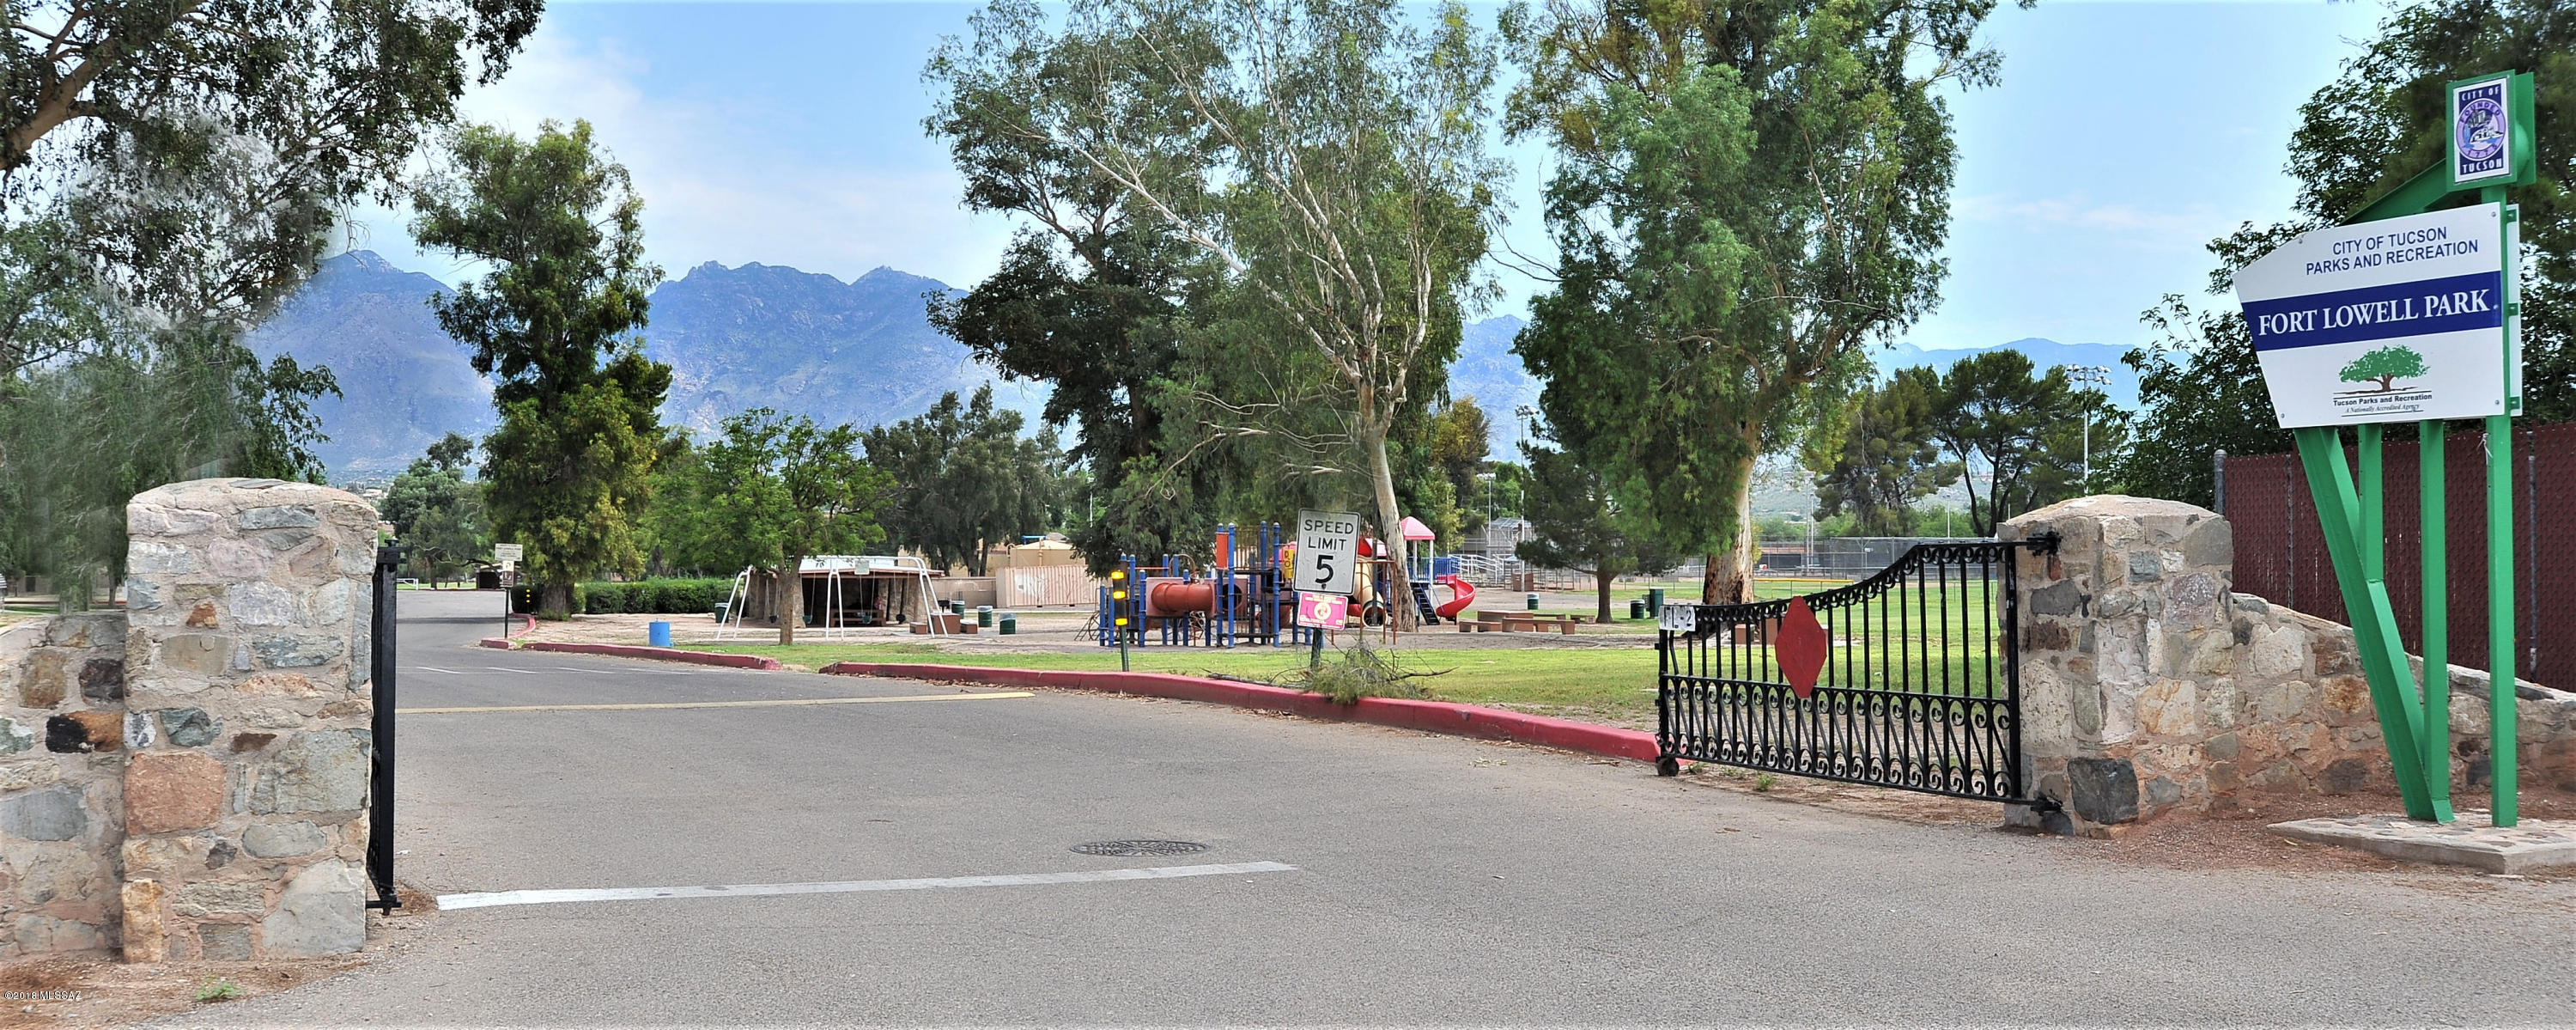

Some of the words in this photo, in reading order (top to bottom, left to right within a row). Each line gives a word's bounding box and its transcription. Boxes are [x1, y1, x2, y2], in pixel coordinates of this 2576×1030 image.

[2462, 89, 2484, 101] CITY
[2488, 86, 2500, 95] OF
[2460, 102, 2500, 123] FOUNDED
[2463, 158, 2502, 174] TUCSON
[2333, 239, 2362, 255] CITY
[2366, 235, 2384, 250] OF
[2388, 226, 2447, 247] TUCSON
[2306, 258, 2350, 276] PARKS
[2354, 253, 2382, 269] AND
[2386, 239, 2478, 265] RECREATION
[2258, 309, 2318, 336] FORT
[2323, 298, 2419, 329] LOWELL
[2424, 289, 2490, 318] PARK
[2394, 393, 2433, 402] Recreation
[1303, 519, 1354, 534] SPEED
[1308, 535, 1347, 551] LIMIT
[1315, 554, 1334, 584] 5
